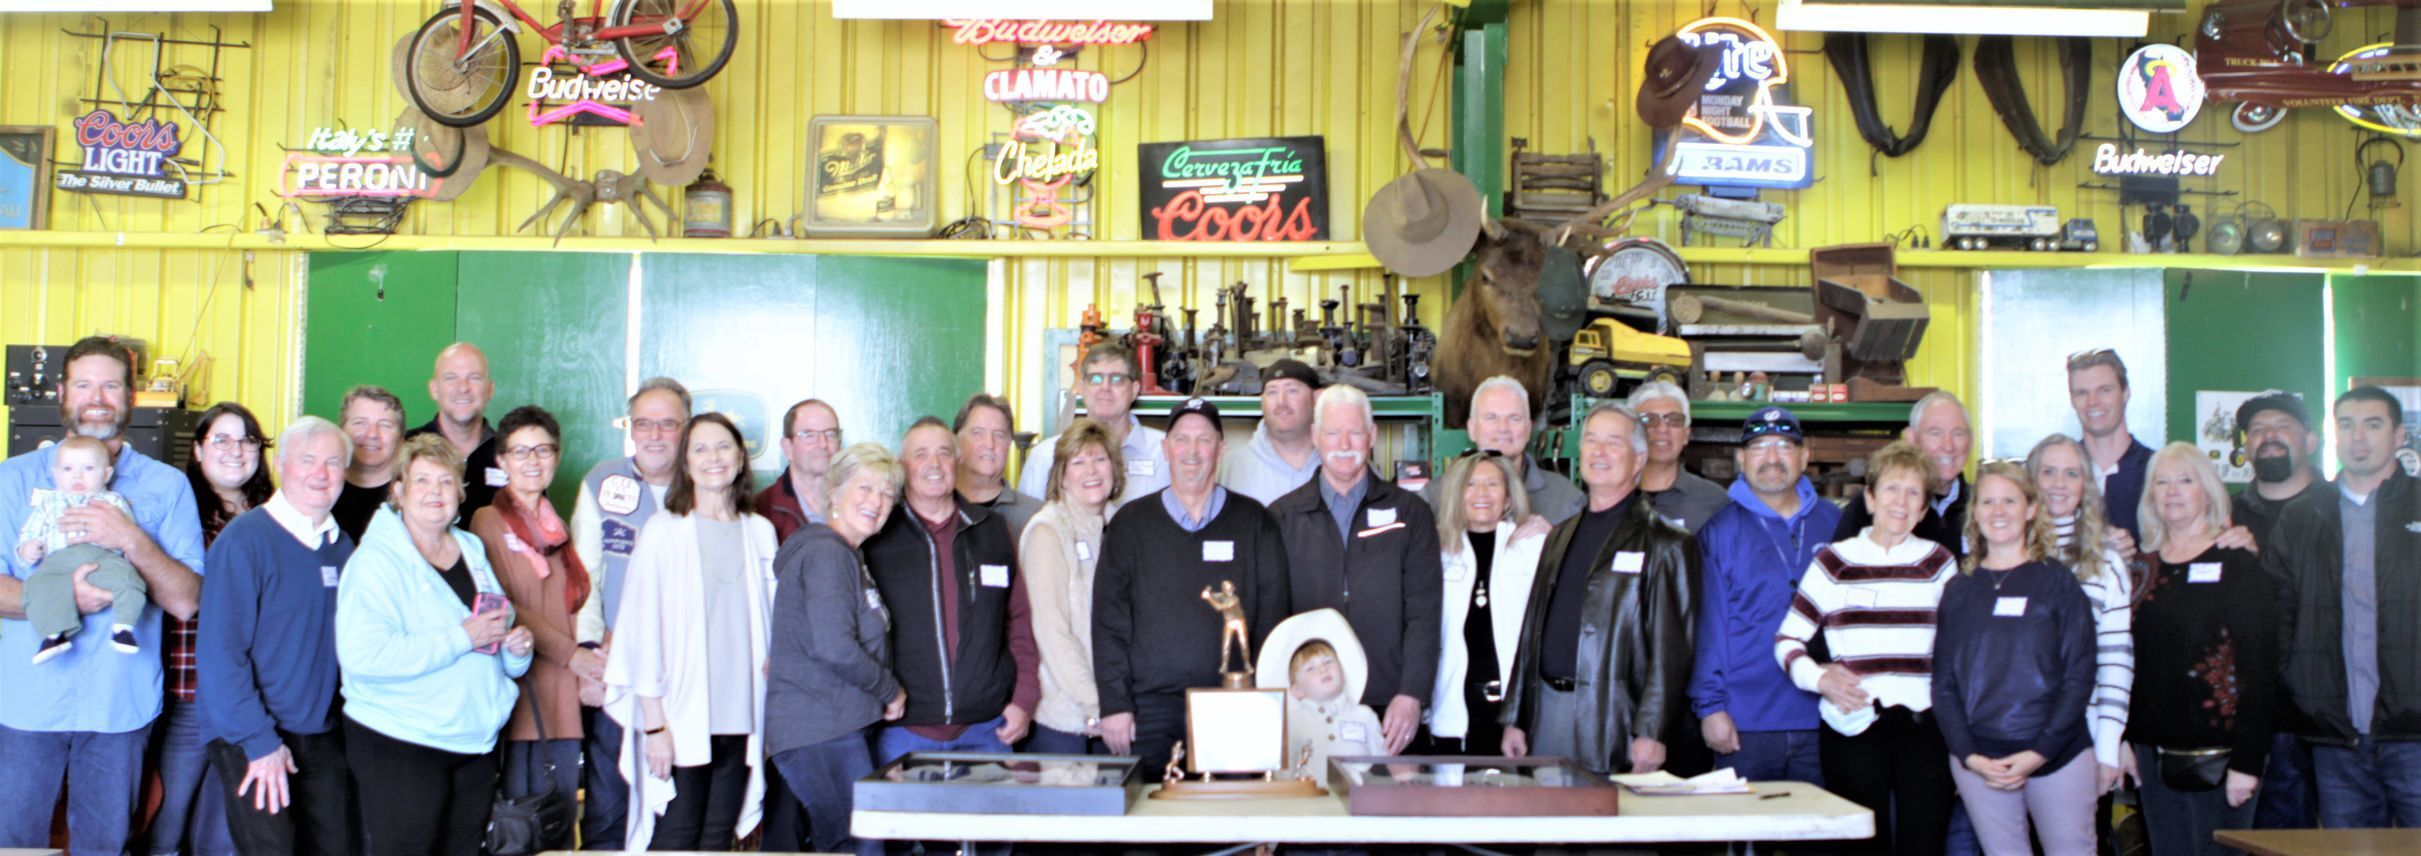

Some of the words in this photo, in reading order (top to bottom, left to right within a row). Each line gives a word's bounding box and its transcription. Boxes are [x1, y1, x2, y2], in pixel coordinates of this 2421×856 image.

[944, 19, 1152, 45] Budweiser
[1032, 45, 1062, 66] &
[527, 67, 662, 100] Budweise
[985, 70, 1108, 102] CLAMATO
[1701, 94, 1744, 106] MONDAY
[1702, 105, 1731, 116] NIGHT
[75, 110, 177, 151] Coors
[307, 127, 388, 157] Italy's
[83, 147, 162, 175] LIGHT
[994, 139, 1099, 185] Chelada
[1162, 146, 1253, 194] Cerveza
[1701, 155, 1793, 175] RAMS
[2093, 143, 2224, 176] Budweiser
[60, 174, 88, 188] The
[89, 176, 132, 191] Silver
[133, 179, 181, 194] Bullet
[298, 162, 427, 191] PERONI
[857, 173, 879, 186] Draft
[1151, 190, 1318, 241] Coors
